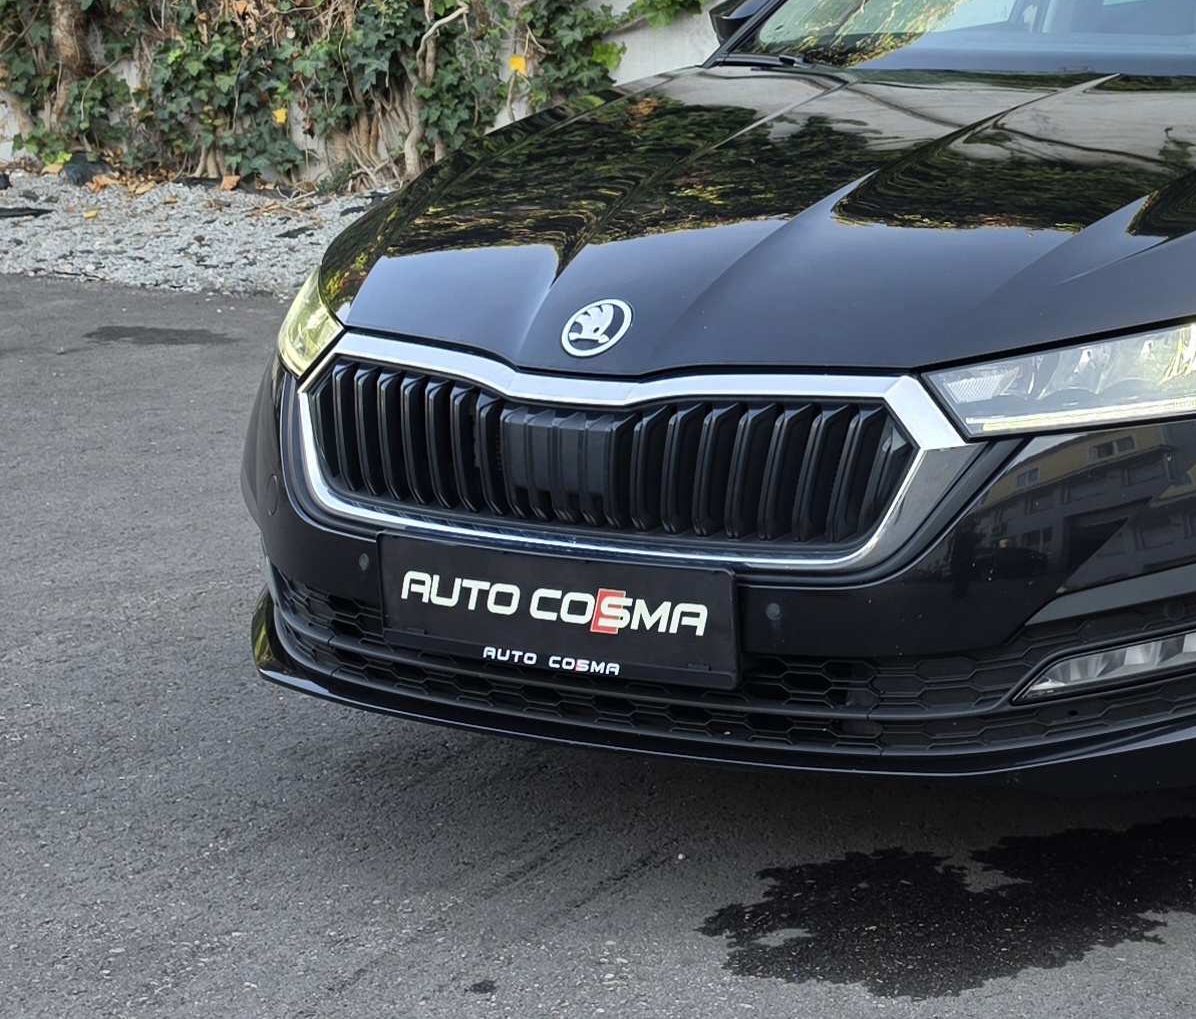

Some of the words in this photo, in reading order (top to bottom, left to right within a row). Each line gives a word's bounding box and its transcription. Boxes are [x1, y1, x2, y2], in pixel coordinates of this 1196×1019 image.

[402, 570, 521, 615] AUTO
[530, 588, 708, 636] COSMA
[482, 646, 538, 666] AUTO
[548, 655, 621, 677] COSMA
